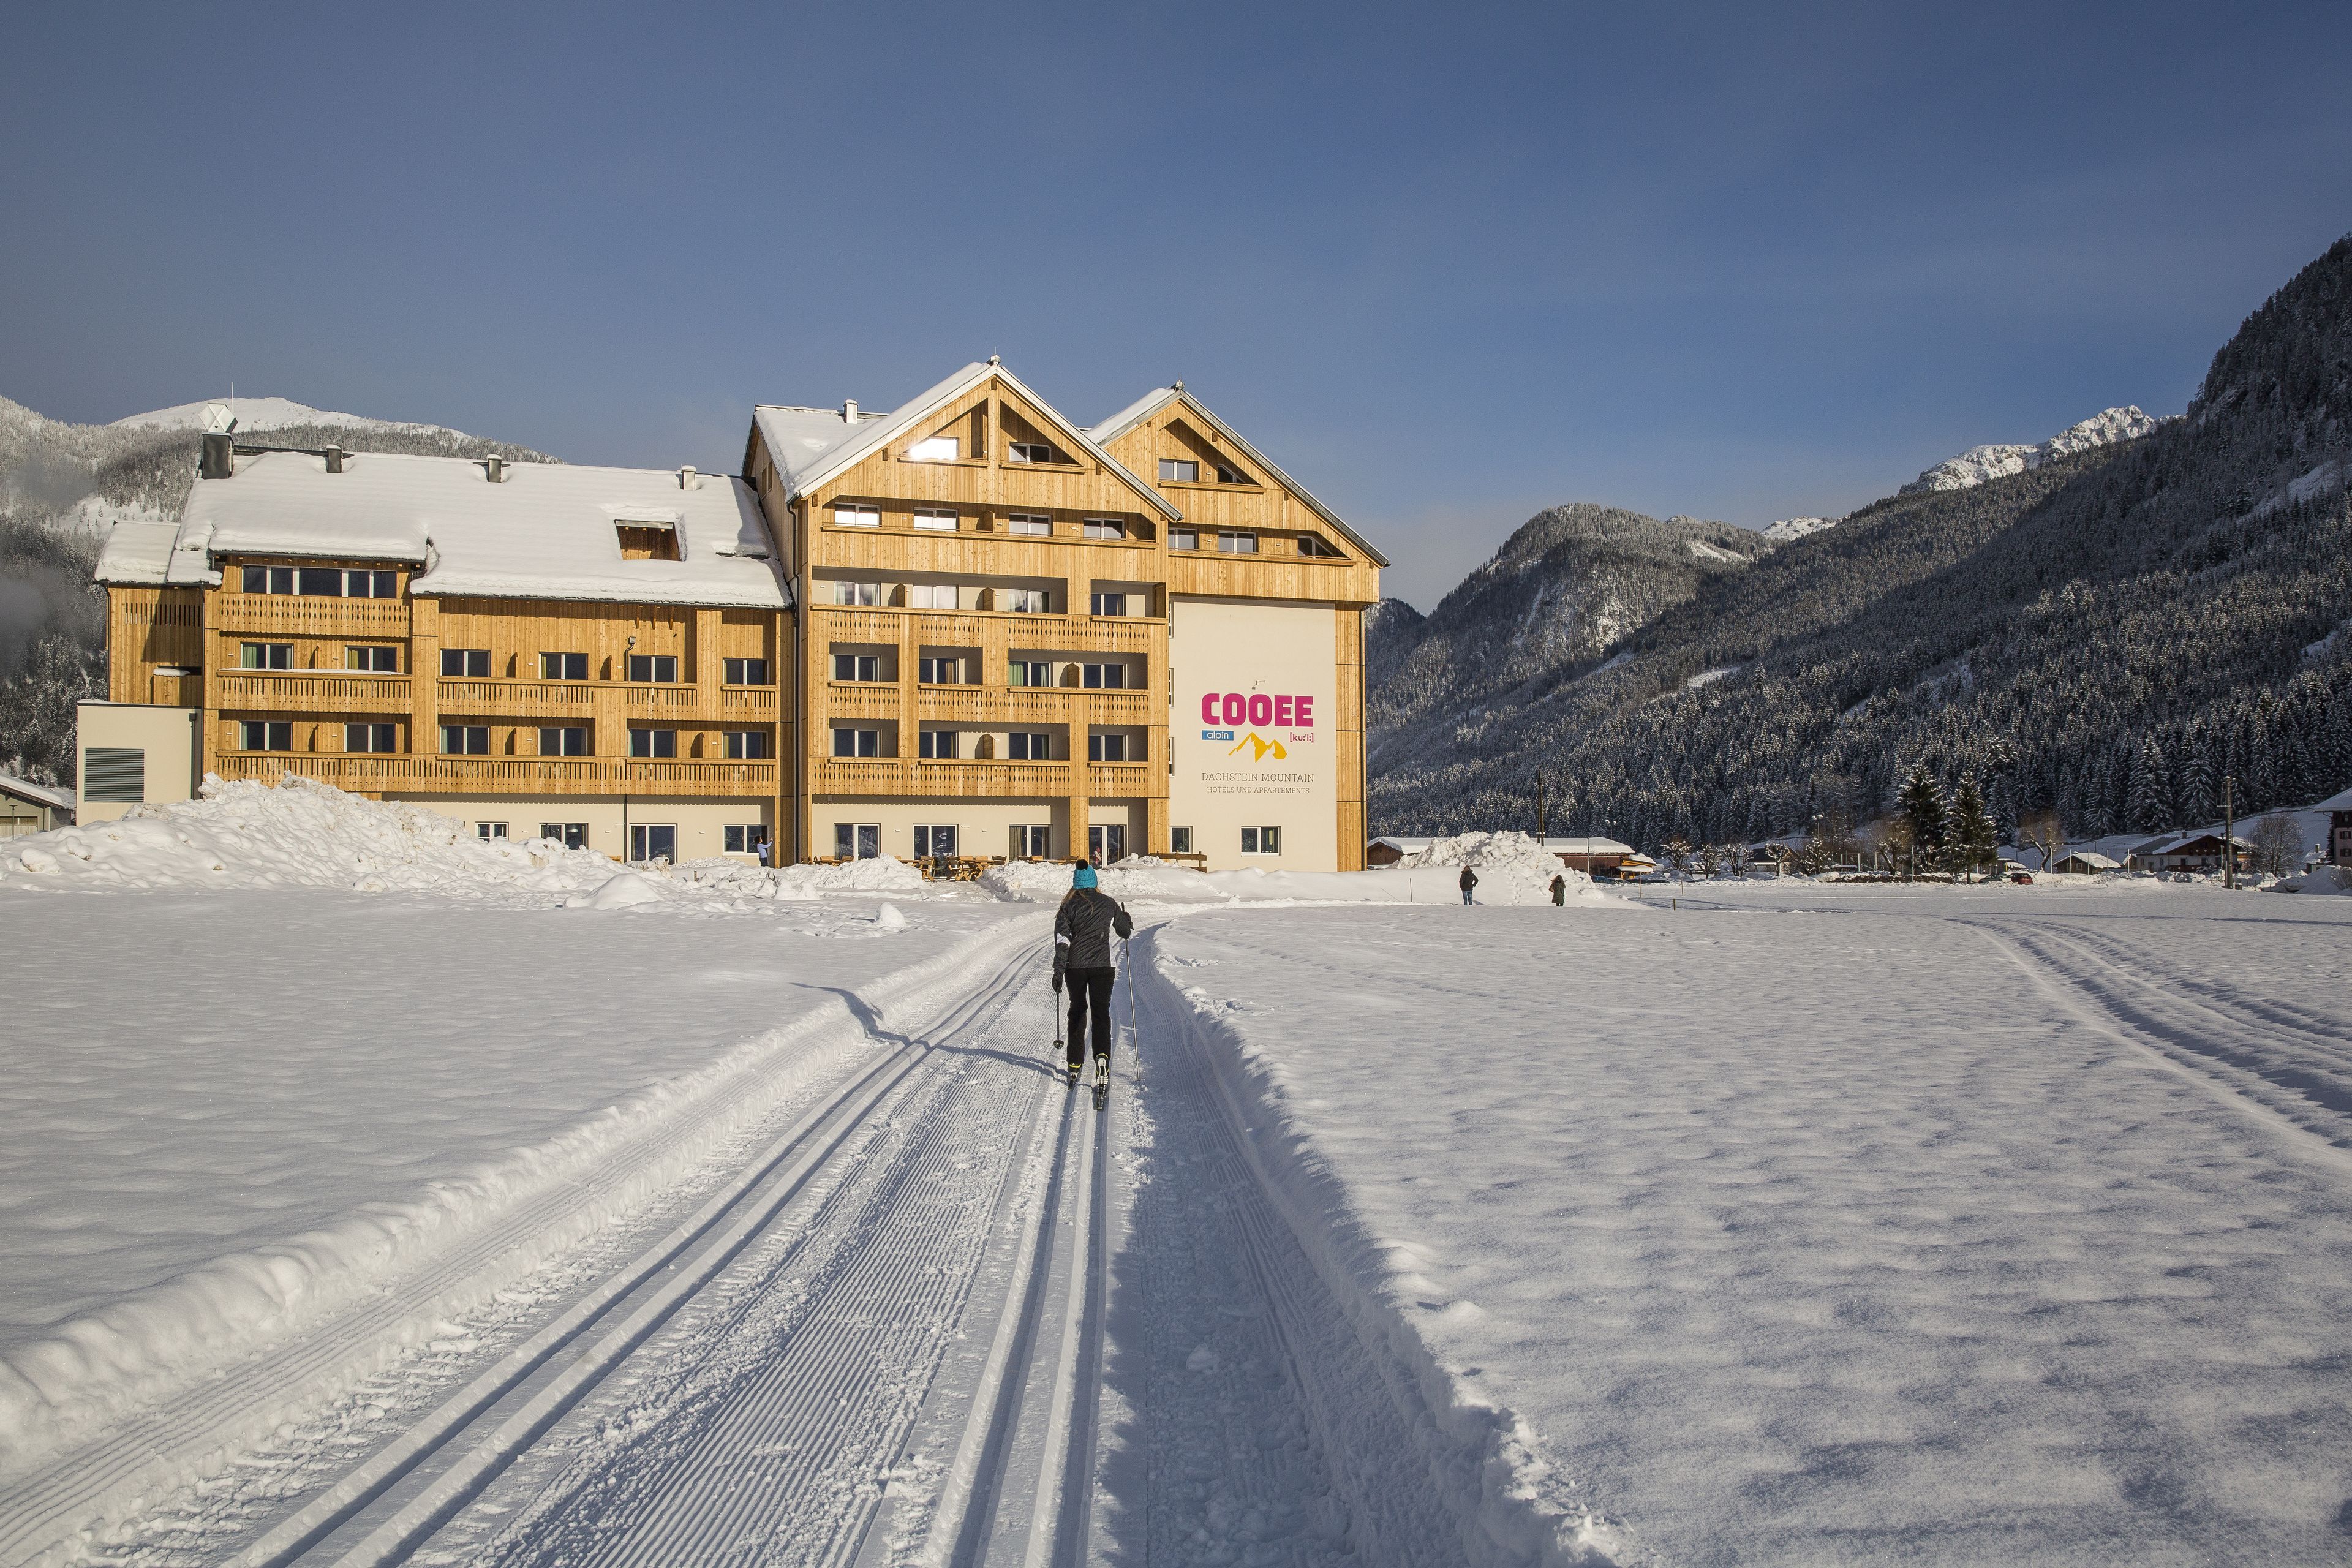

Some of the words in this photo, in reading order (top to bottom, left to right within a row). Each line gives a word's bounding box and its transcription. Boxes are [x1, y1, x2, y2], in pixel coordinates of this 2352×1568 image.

[1201, 693, 1314, 727] COOEE
[1207, 730, 1229, 741] alpin
[1202, 772, 1258, 782] DACHSTEIN
[1261, 773, 1314, 782] MOUNTAIN
